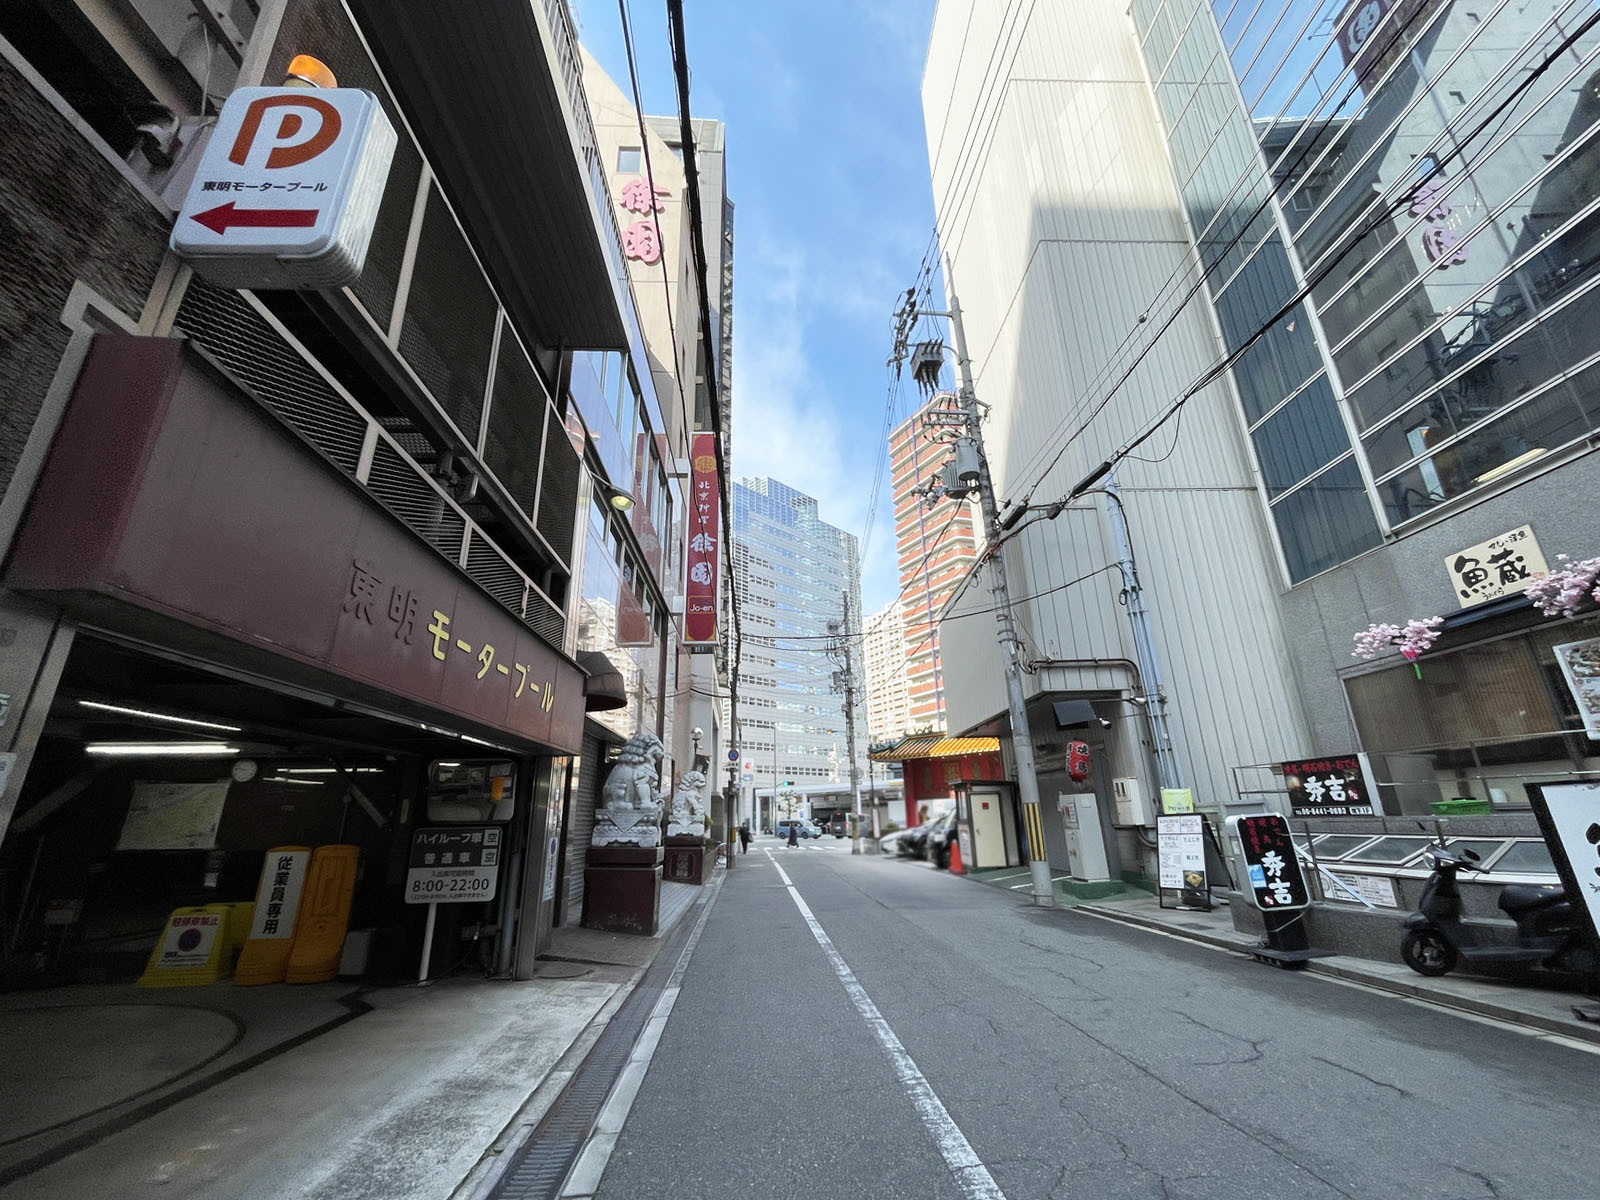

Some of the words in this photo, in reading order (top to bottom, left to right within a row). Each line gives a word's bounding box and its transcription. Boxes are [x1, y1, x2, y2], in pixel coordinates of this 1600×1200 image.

[229, 95, 342, 170] P
[201, 181, 328, 192] 東明モータープール
[698, 480, 711, 524] 北京料理
[690, 603, 714, 612] Jo-en
[1303, 774, 1346, 803] 秀吉
[416, 832, 482, 845] ハイルーフ車
[412, 878, 490, 892] 8:00-22:00
[1261, 850, 1292, 904] 秀吉
[262, 856, 294, 935] 従業員専用
